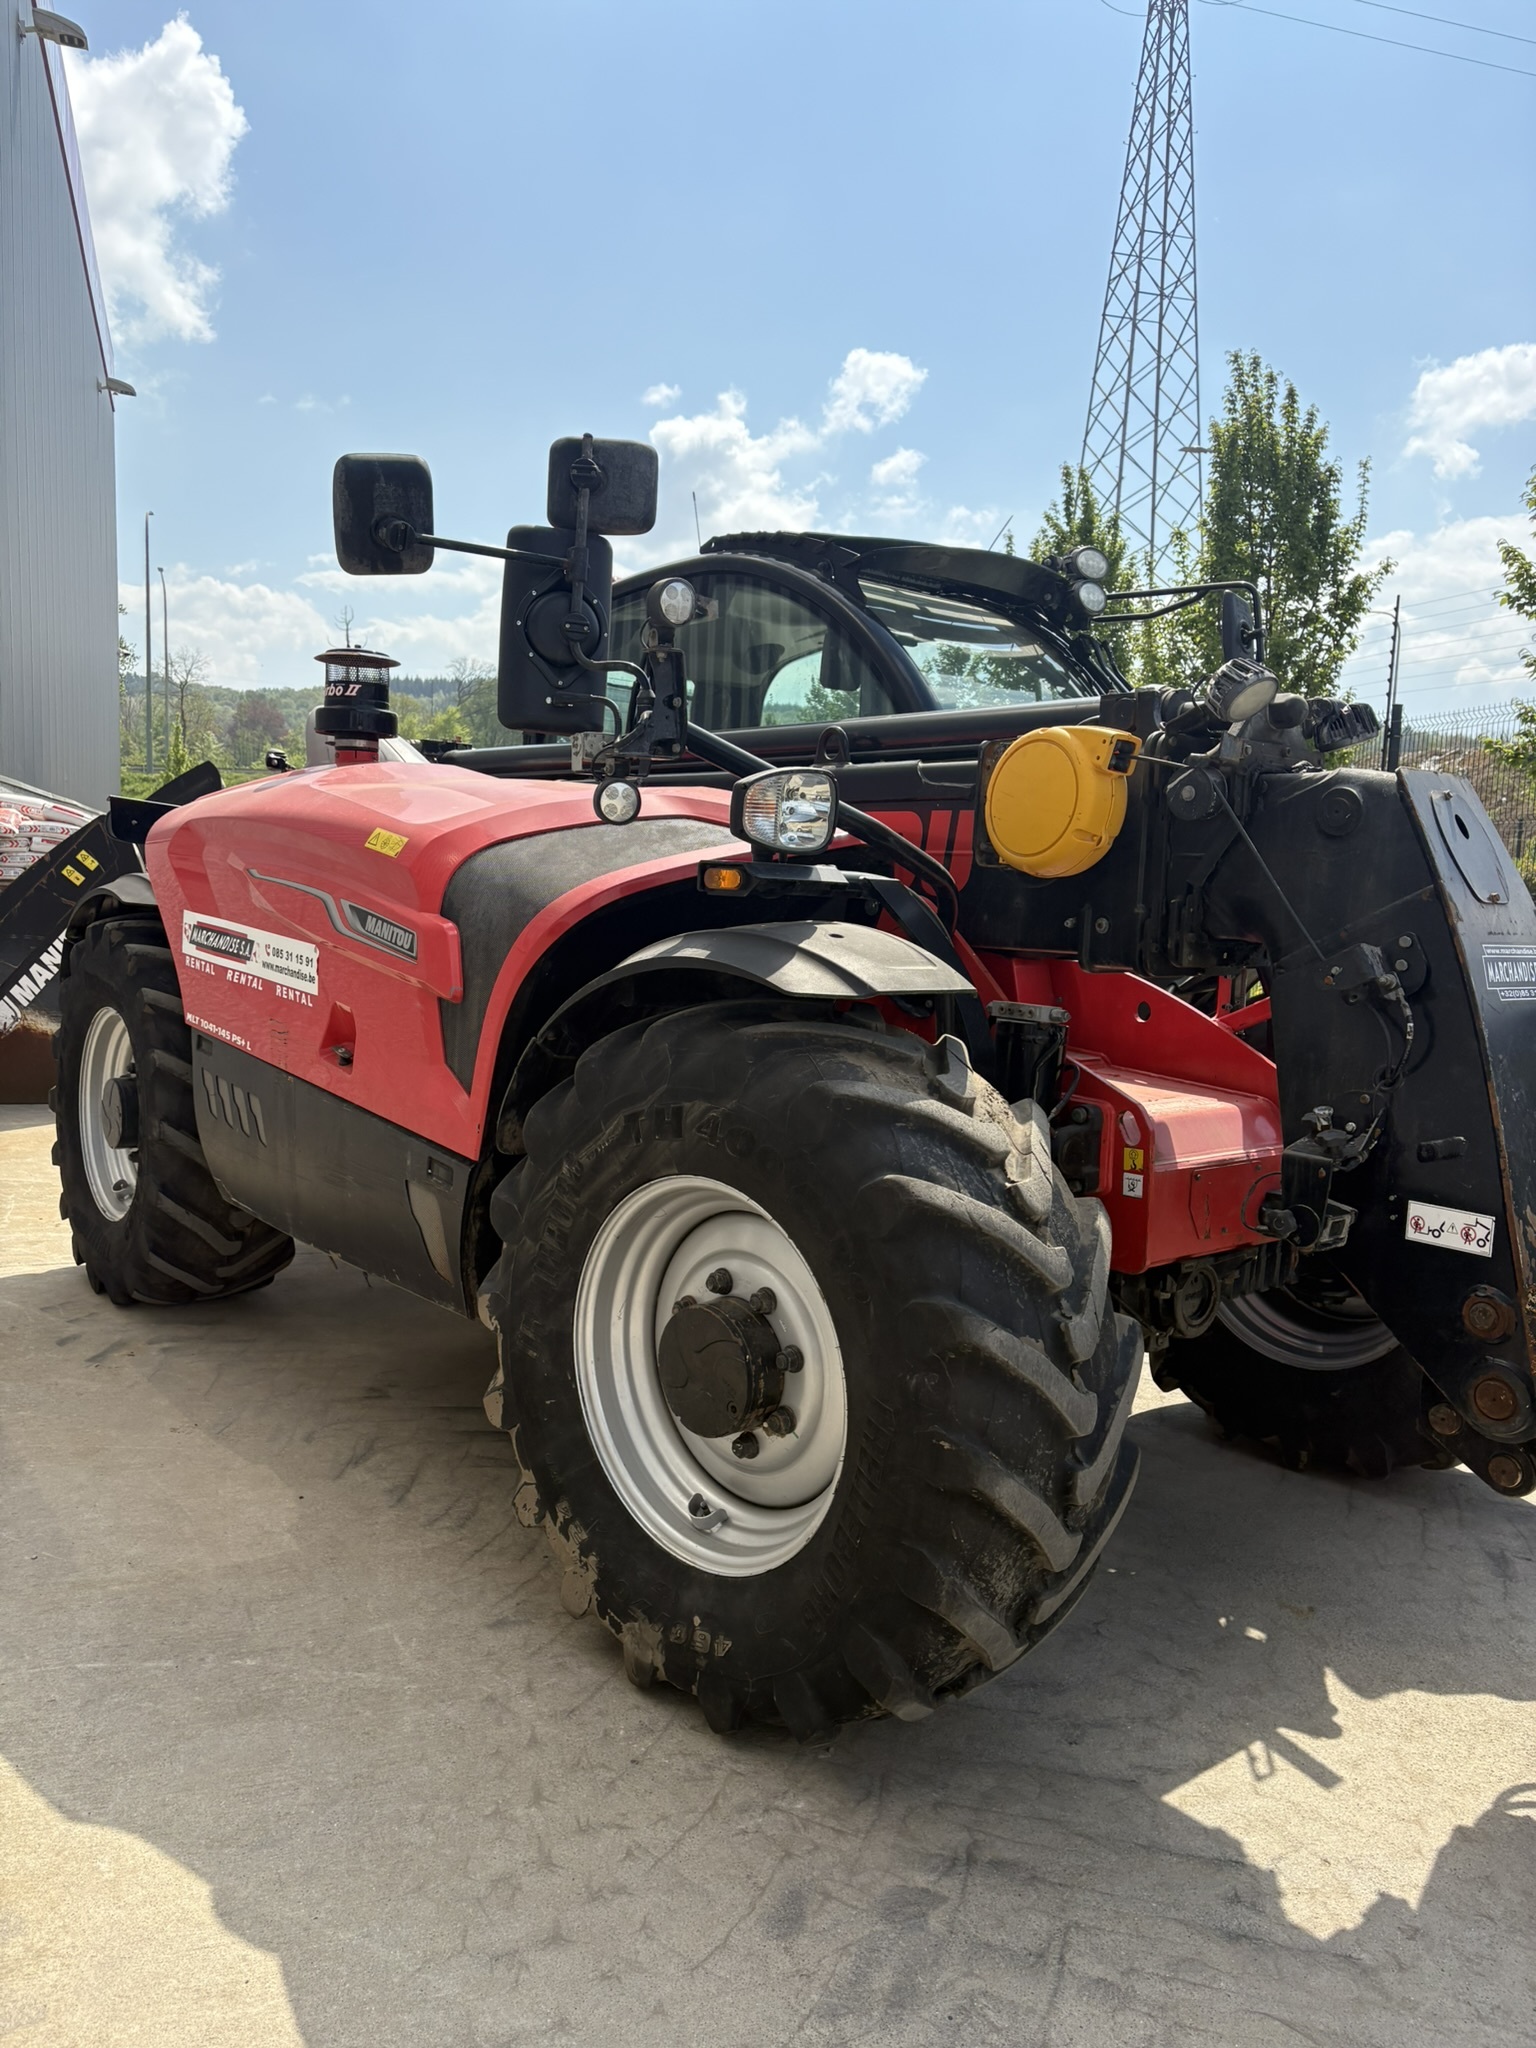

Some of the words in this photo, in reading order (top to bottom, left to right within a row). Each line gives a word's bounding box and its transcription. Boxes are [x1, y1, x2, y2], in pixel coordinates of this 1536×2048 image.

[191, 927, 239, 953] MARCHANDISE
[365, 915, 413, 950] MANITOU
[272, 947, 284, 959] 085
[285, 950, 293, 962] 31
[296, 953, 304, 965] 15
[305, 956, 314, 968] 91
[185, 955, 216, 976] RENTAL
[226, 969, 263, 991] RENTAL
[276, 984, 313, 1007] RENTAL
[186, 1012, 200, 1025] MLT
[200, 1018, 231, 1040] 1041-145
[246, 1041, 252, 1051] L
